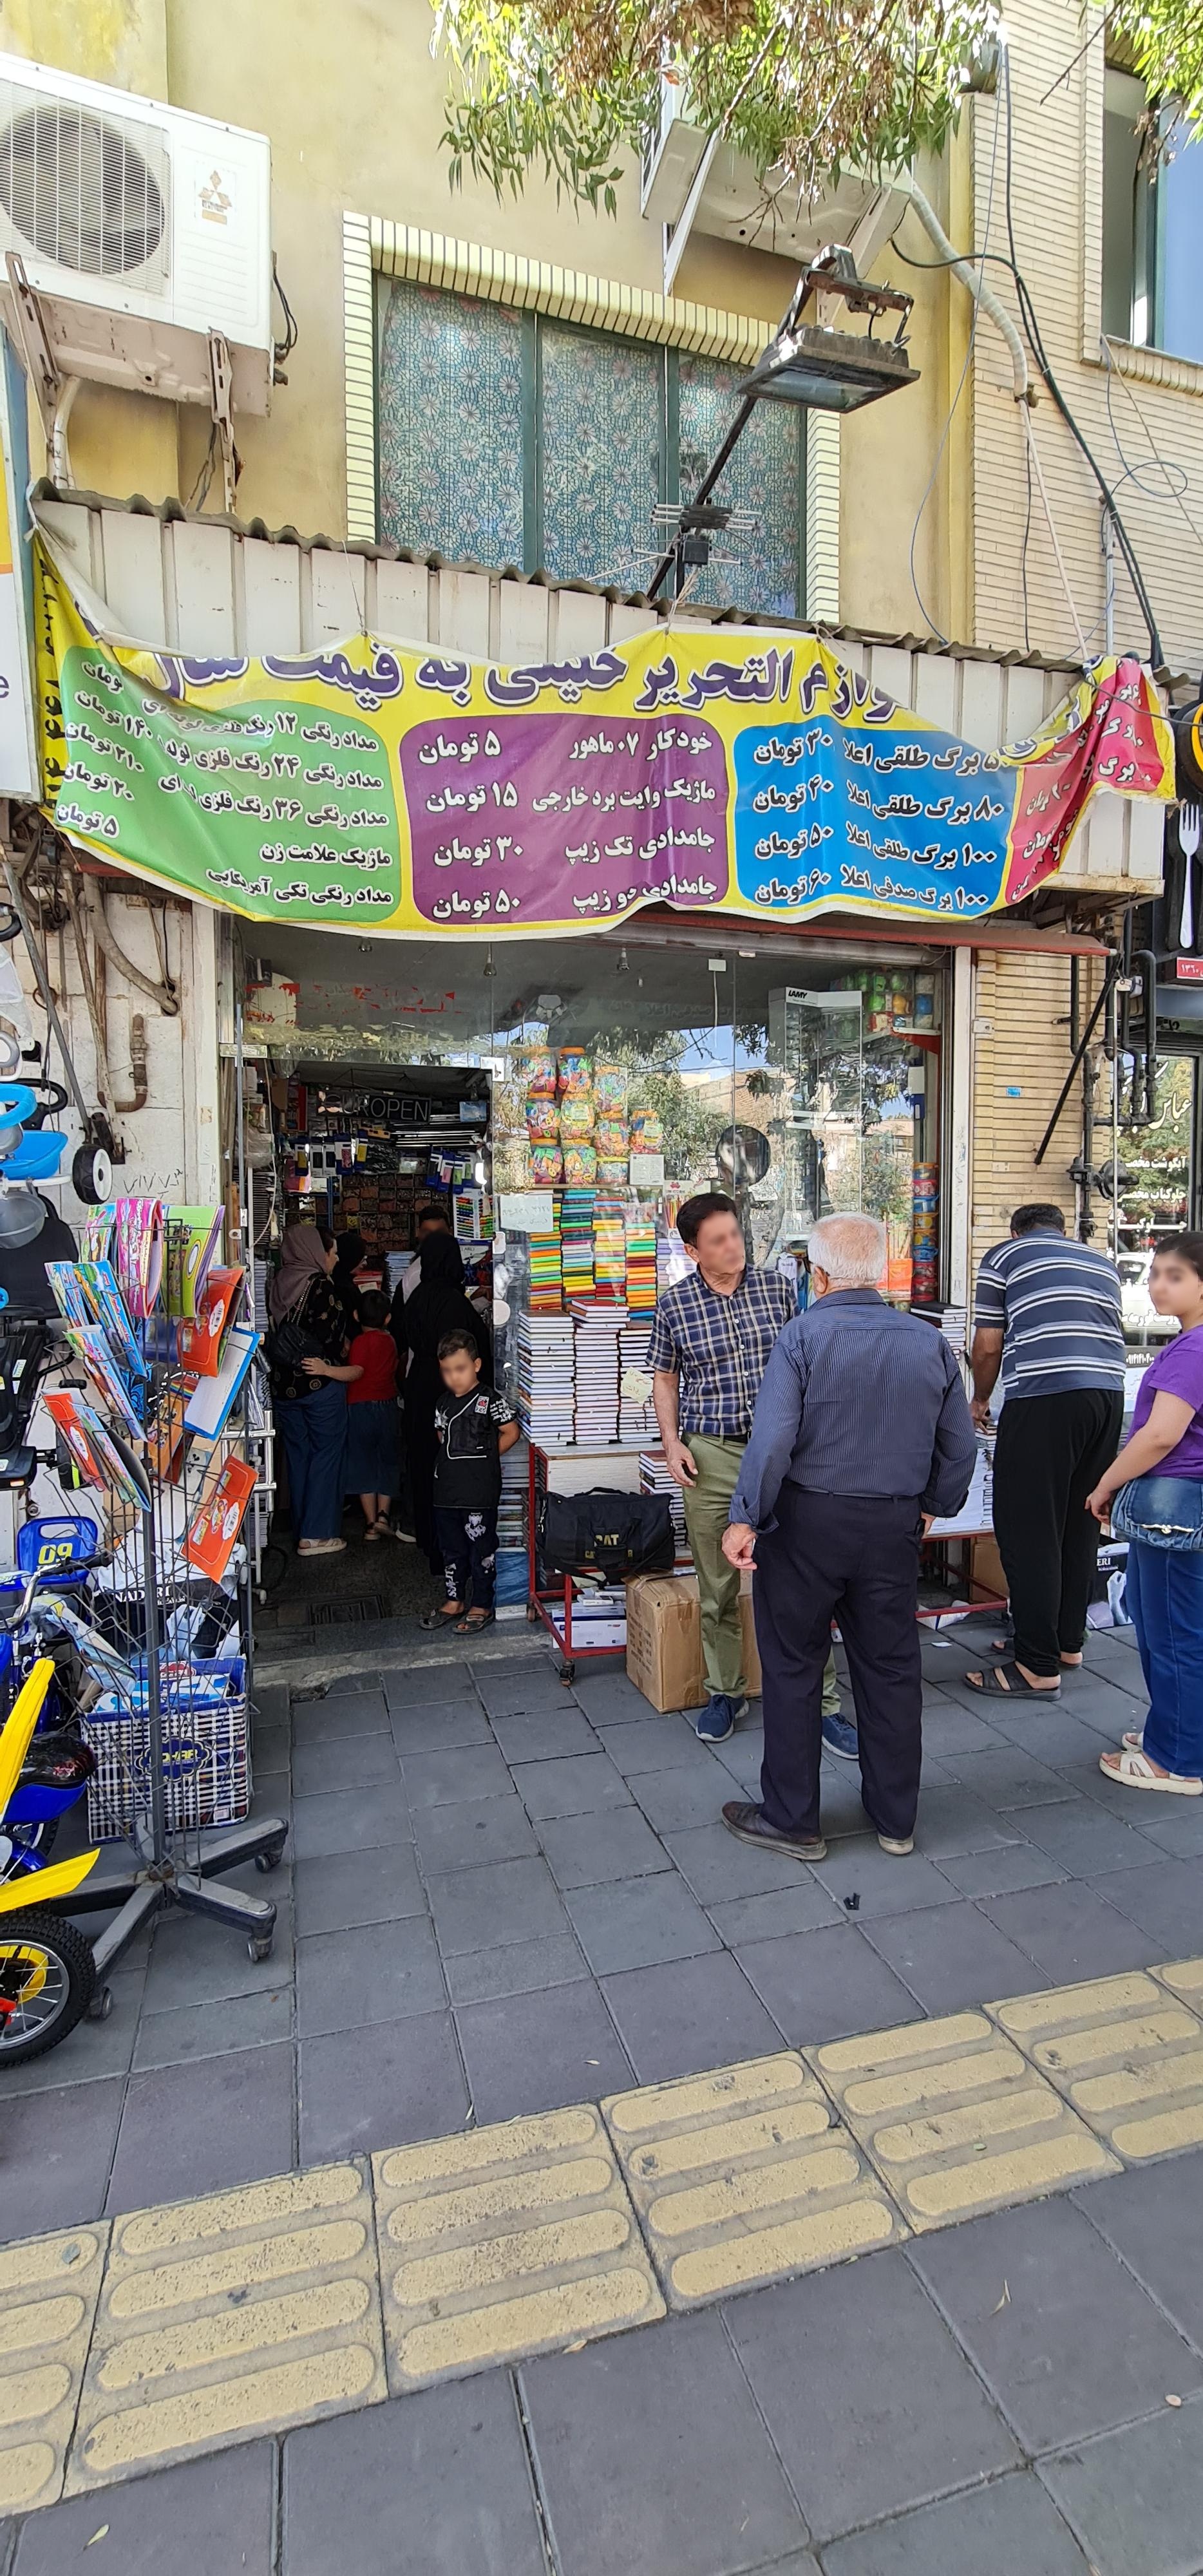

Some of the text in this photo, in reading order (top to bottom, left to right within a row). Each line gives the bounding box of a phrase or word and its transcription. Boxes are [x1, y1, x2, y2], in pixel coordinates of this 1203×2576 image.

[261, 642, 403, 709] قیمت
[416, 658, 471, 705] به
[636, 647, 794, 709] التحریر
[75, 691, 122, 726] تومان
[124, 715, 153, 739] ۱۴۰
[245, 715, 274, 736] رنگ
[276, 712, 297, 733] ۱۲
[302, 722, 339, 746] رنگی
[66, 723, 111, 753] تومان
[343, 732, 378, 751] مداد
[418, 733, 479, 764] تومان
[484, 730, 502, 757] ۵
[569, 732, 614, 759] ماهور
[807, 728, 833, 754] ۳۰
[112, 745, 144, 772] ۲۱۰
[194, 748, 232, 770] فلزی
[753, 738, 802, 765] تومان
[842, 738, 873, 765] اعلا
[875, 744, 929, 772] طلقی
[934, 746, 980, 775] برگ
[234, 753, 272, 778] رنگ
[272, 753, 301, 777] ۲۴
[305, 763, 345, 789] رنگی
[346, 772, 383, 789] مداد
[200, 791, 234, 814] فلزی
[426, 777, 716, 813] ماژیک وایت برد خارجی ۱۵ تومان
[752, 775, 1004, 824] ۸۰ برگ طلقی اعلا ۴۰ تومان
[56, 803, 104, 832] تومان
[63, 762, 392, 870] ماژیک علامت زن ۲۰ تومان
[236, 795, 272, 822] رنگ
[272, 797, 303, 820] ۳۶
[305, 805, 349, 828] رنگی
[350, 810, 389, 828] مداد
[102, 815, 120, 838] ۵
[433, 826, 715, 867] جامدادی تک زیپ ۳۰ تومان
[754, 822, 997, 869] ۱۰۰ برگ طلقی اعلا ۵۰ تومان
[642, 874, 717, 901] جامدادی
[808, 868, 831, 894] ۶۰
[840, 864, 871, 889] اعلا
[873, 876, 917, 899] صدفی
[274, 882, 308, 902] تکی
[310, 886, 354, 907] رنگی
[355, 887, 393, 904] مداد
[495, 889, 521, 913] ۵۰
[573, 889, 611, 914] زیپ
[754, 876, 806, 904] تومان
[919, 887, 953, 911] برگ
[955, 886, 989, 908] ۱۰۰
[431, 891, 491, 919] تومان
[788, 990, 807, 998] LAMY
[39, 1543, 72, 1565] 09
[115, 1586, 170, 1602] NADRI
